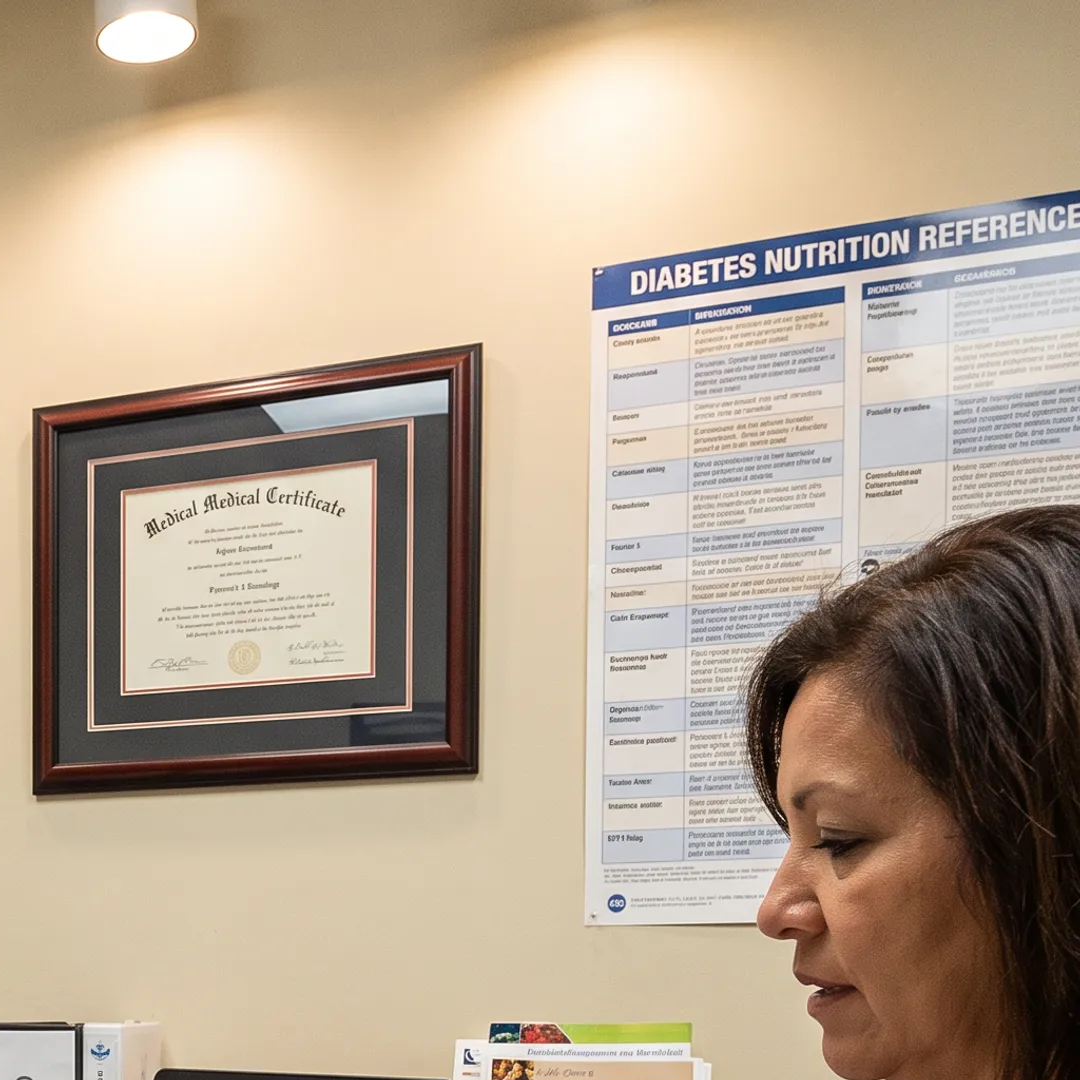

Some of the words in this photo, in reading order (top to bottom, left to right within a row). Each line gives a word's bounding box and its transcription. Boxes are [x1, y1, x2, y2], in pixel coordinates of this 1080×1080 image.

[630, 253, 757, 296] DIABETES
[764, 229, 910, 276] NUTRITION
[919, 202, 1080, 251] REFERENCE
[144, 500, 199, 539] Medical
[203, 488, 260, 514] Medical
[266, 486, 346, 518] Certificate
